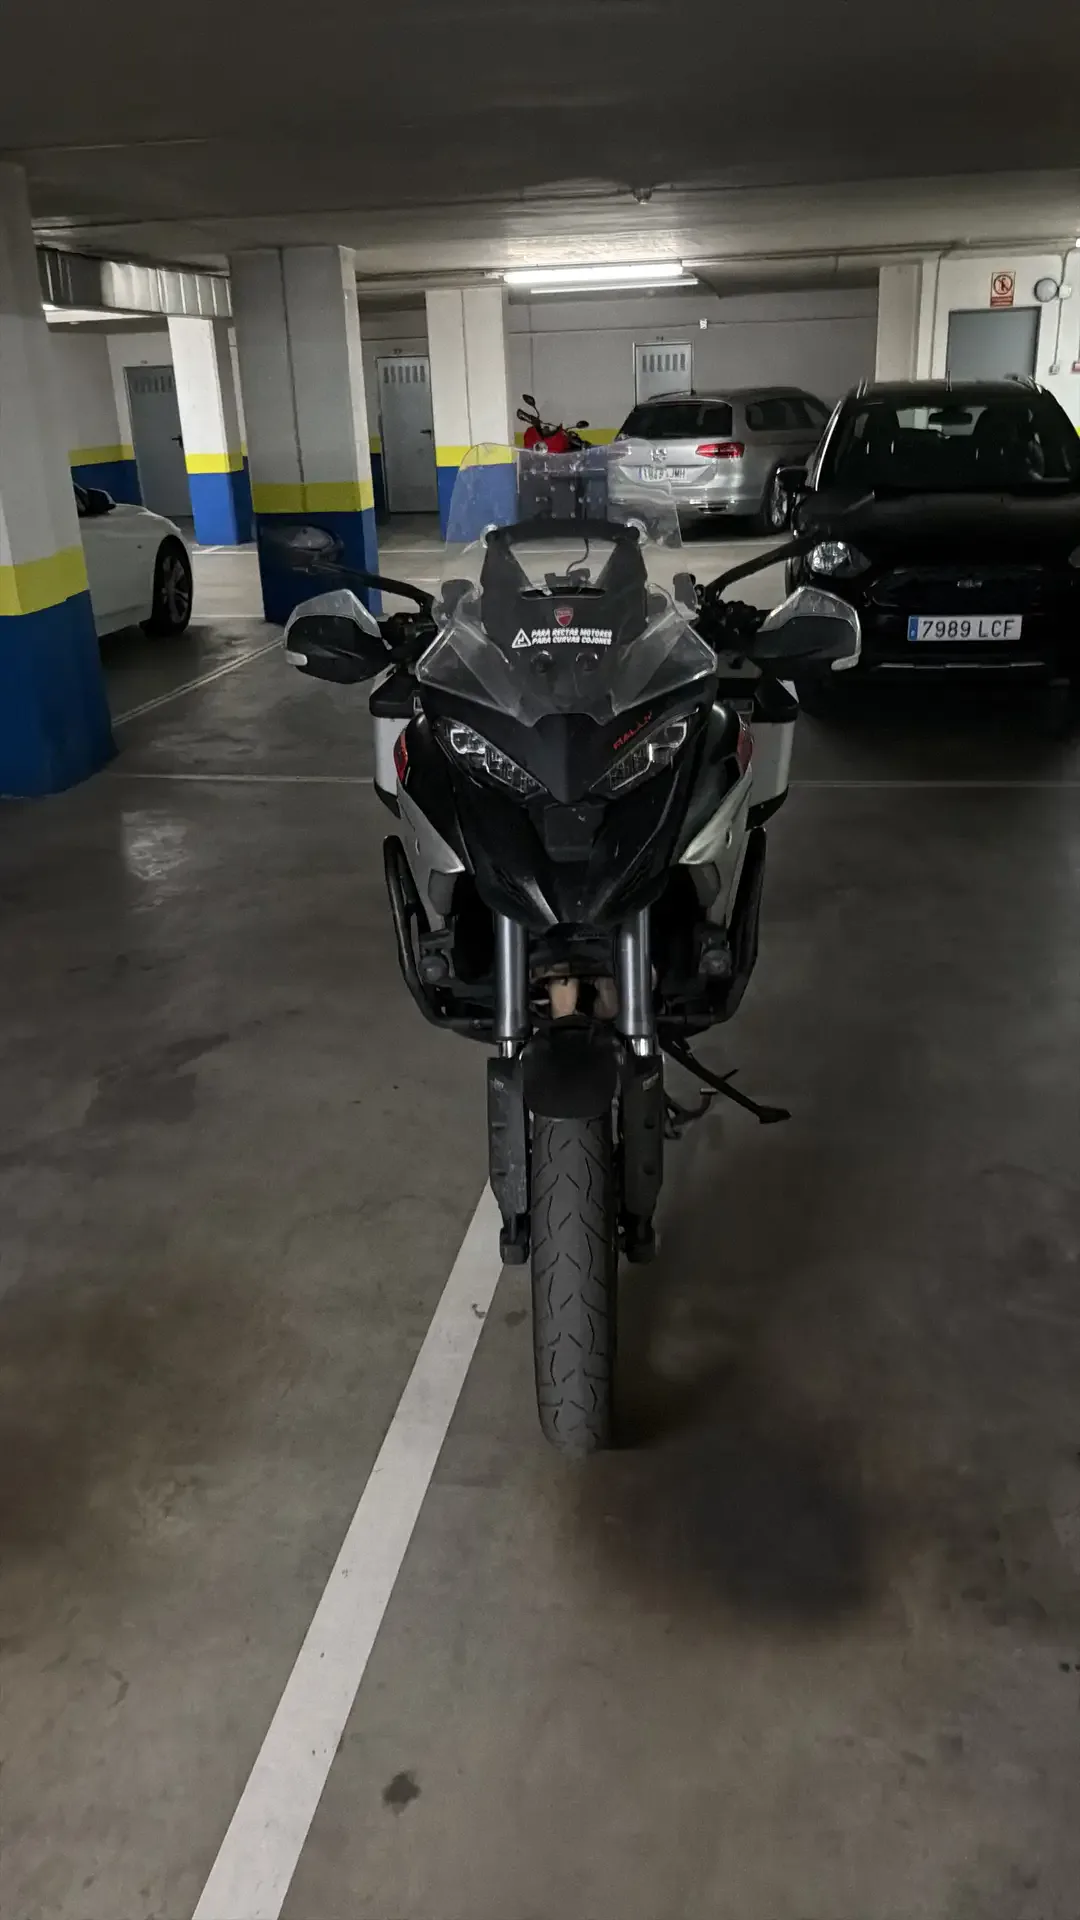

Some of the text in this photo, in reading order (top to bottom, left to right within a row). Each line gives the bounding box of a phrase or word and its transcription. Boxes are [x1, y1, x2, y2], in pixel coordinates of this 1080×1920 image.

[531, 628, 612, 638] PARA RECTAS MOTORES
[922, 620, 1015, 639] 7989 LCF
[531, 637, 551, 645] PARA
[552, 636, 580, 644] CURVAS
